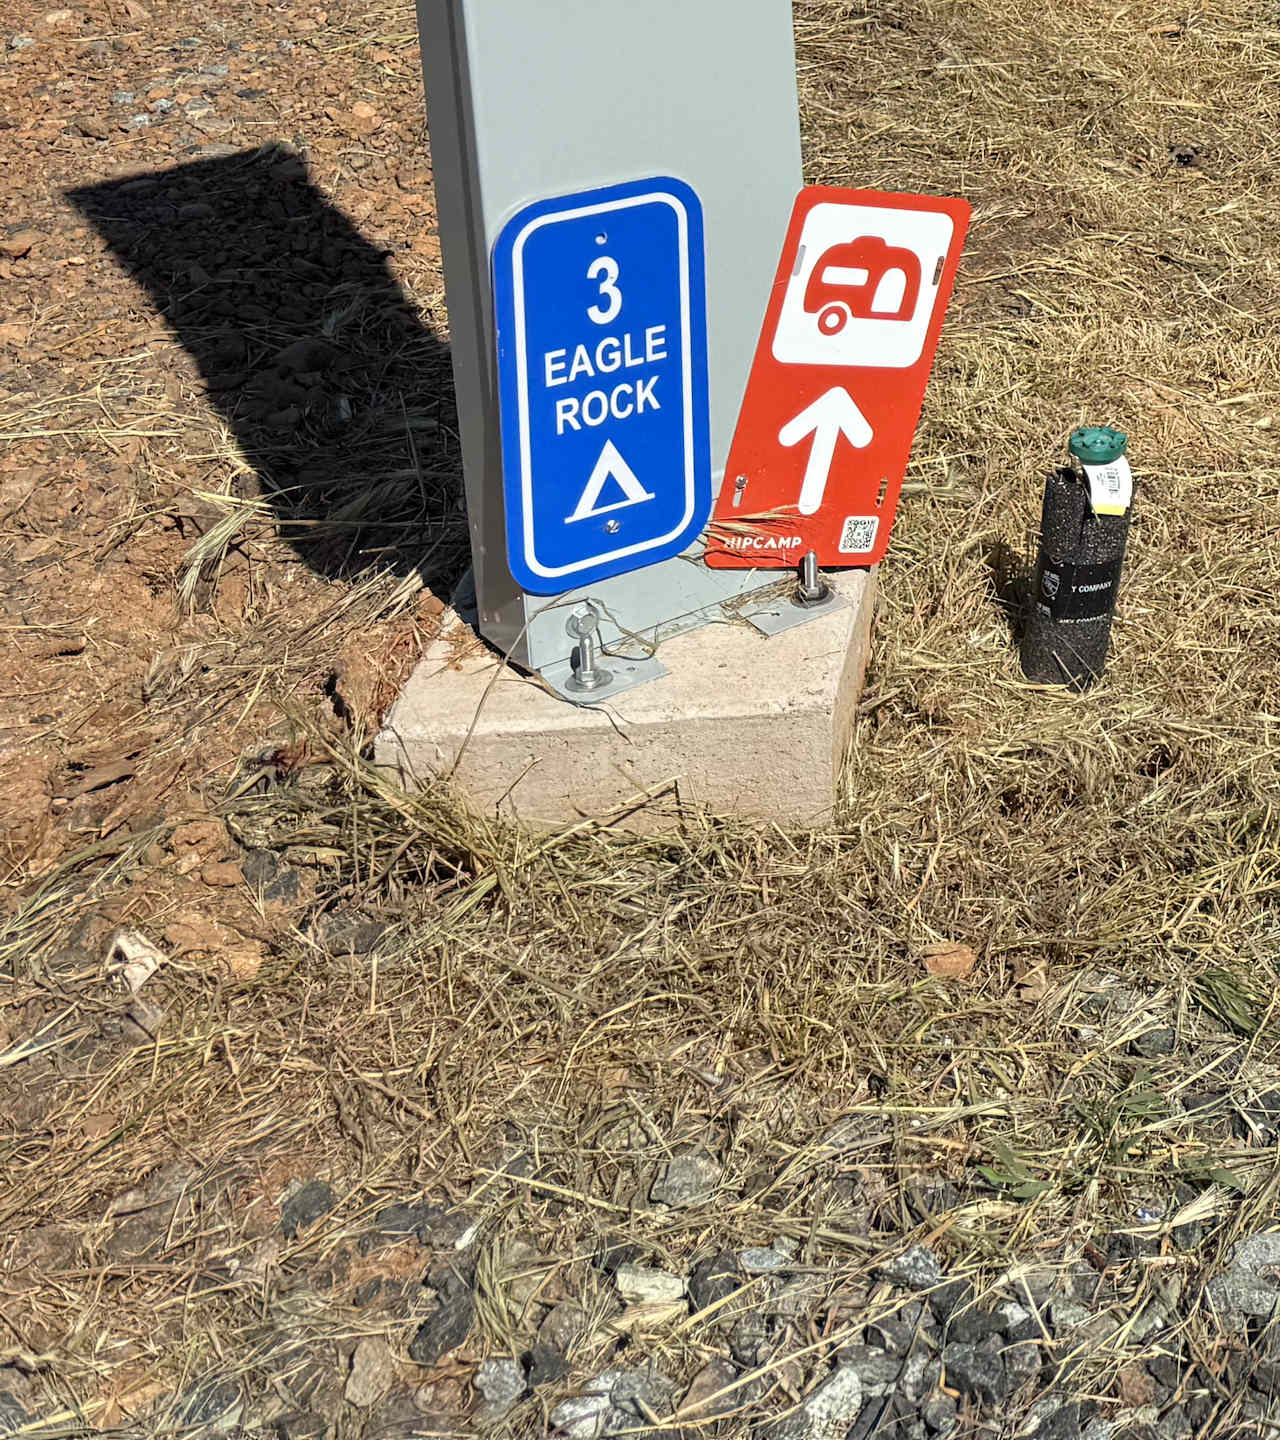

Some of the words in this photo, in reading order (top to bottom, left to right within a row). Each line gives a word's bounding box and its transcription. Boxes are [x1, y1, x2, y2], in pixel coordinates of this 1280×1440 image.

[586, 256, 623, 325] 3
[544, 324, 668, 388] EAGLE
[556, 375, 662, 436] ROCK
[1078, 580, 1113, 594] COMPANY
